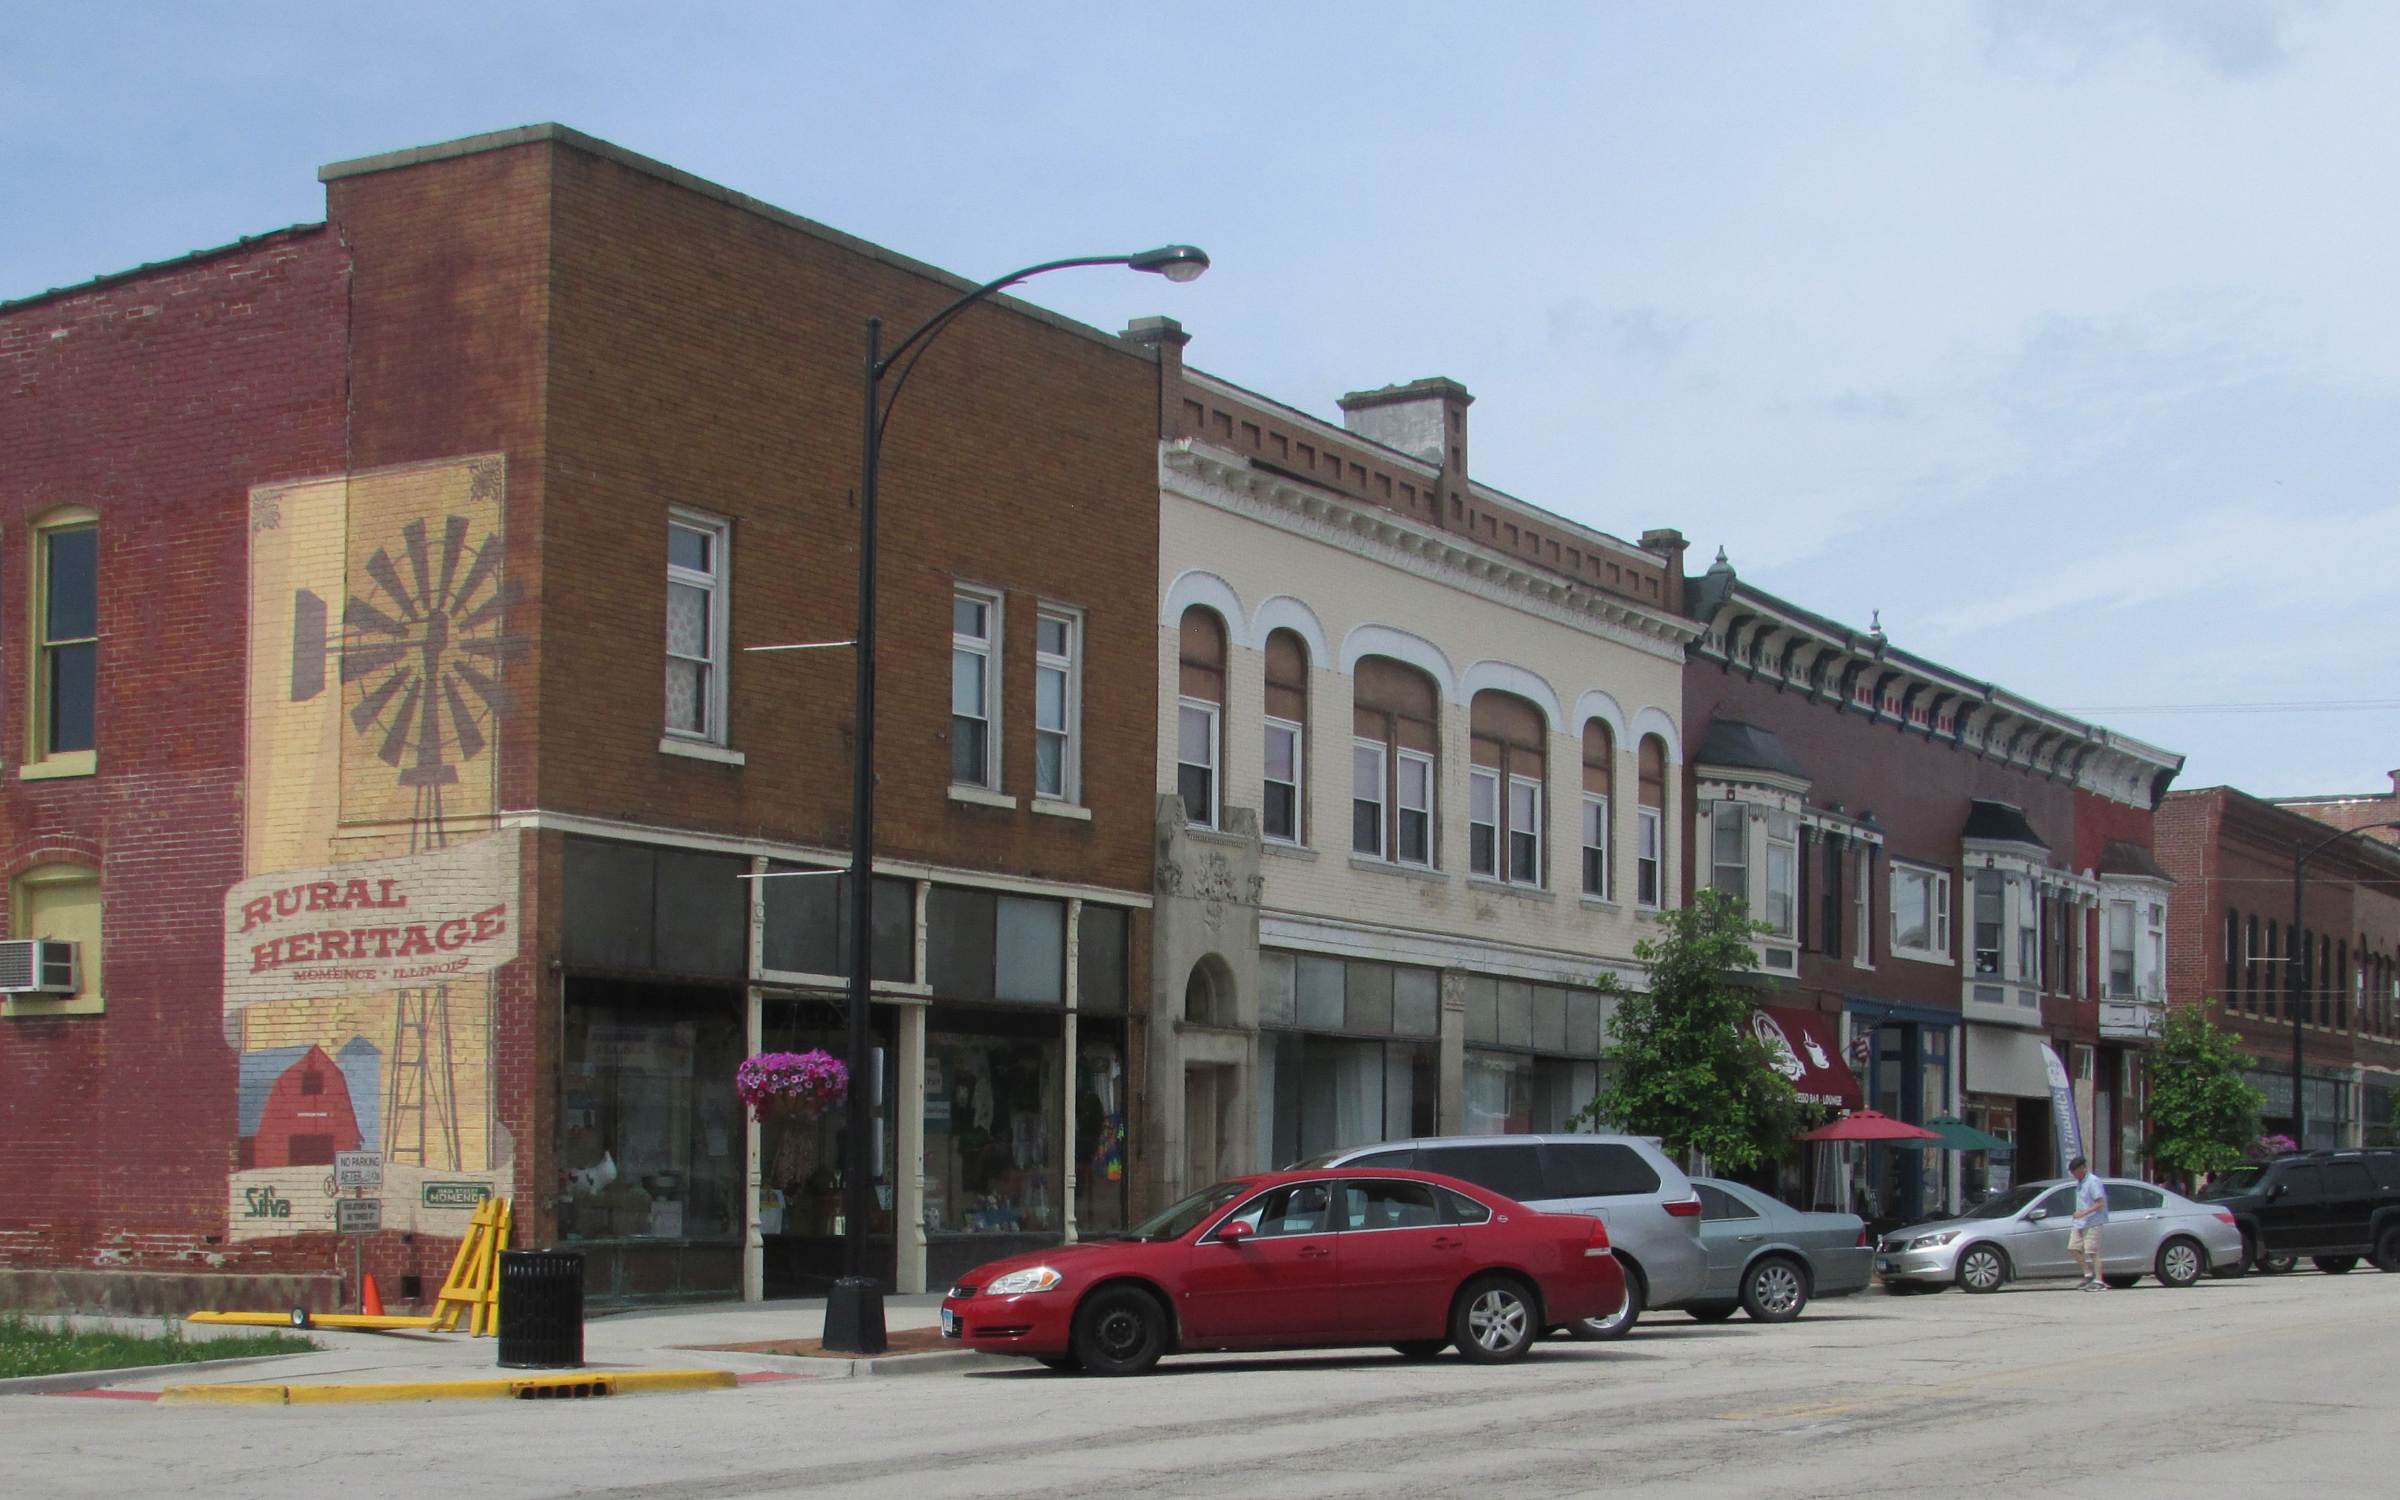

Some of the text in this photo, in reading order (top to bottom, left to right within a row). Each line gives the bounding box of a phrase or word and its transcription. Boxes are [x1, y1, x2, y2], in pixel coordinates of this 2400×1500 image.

[240, 878, 407, 934] RURAL
[250, 902, 507, 974] HERITAGE
[293, 957, 470, 981] MOMENCE ILLINOIS
[1810, 1093, 1819, 1104] BAR
[1823, 1095, 1842, 1106] LOUNGE
[340, 1156, 380, 1167] NO PARKING
[244, 1186, 290, 1217] Silva
[430, 1193, 486, 1202] MOMENCE
